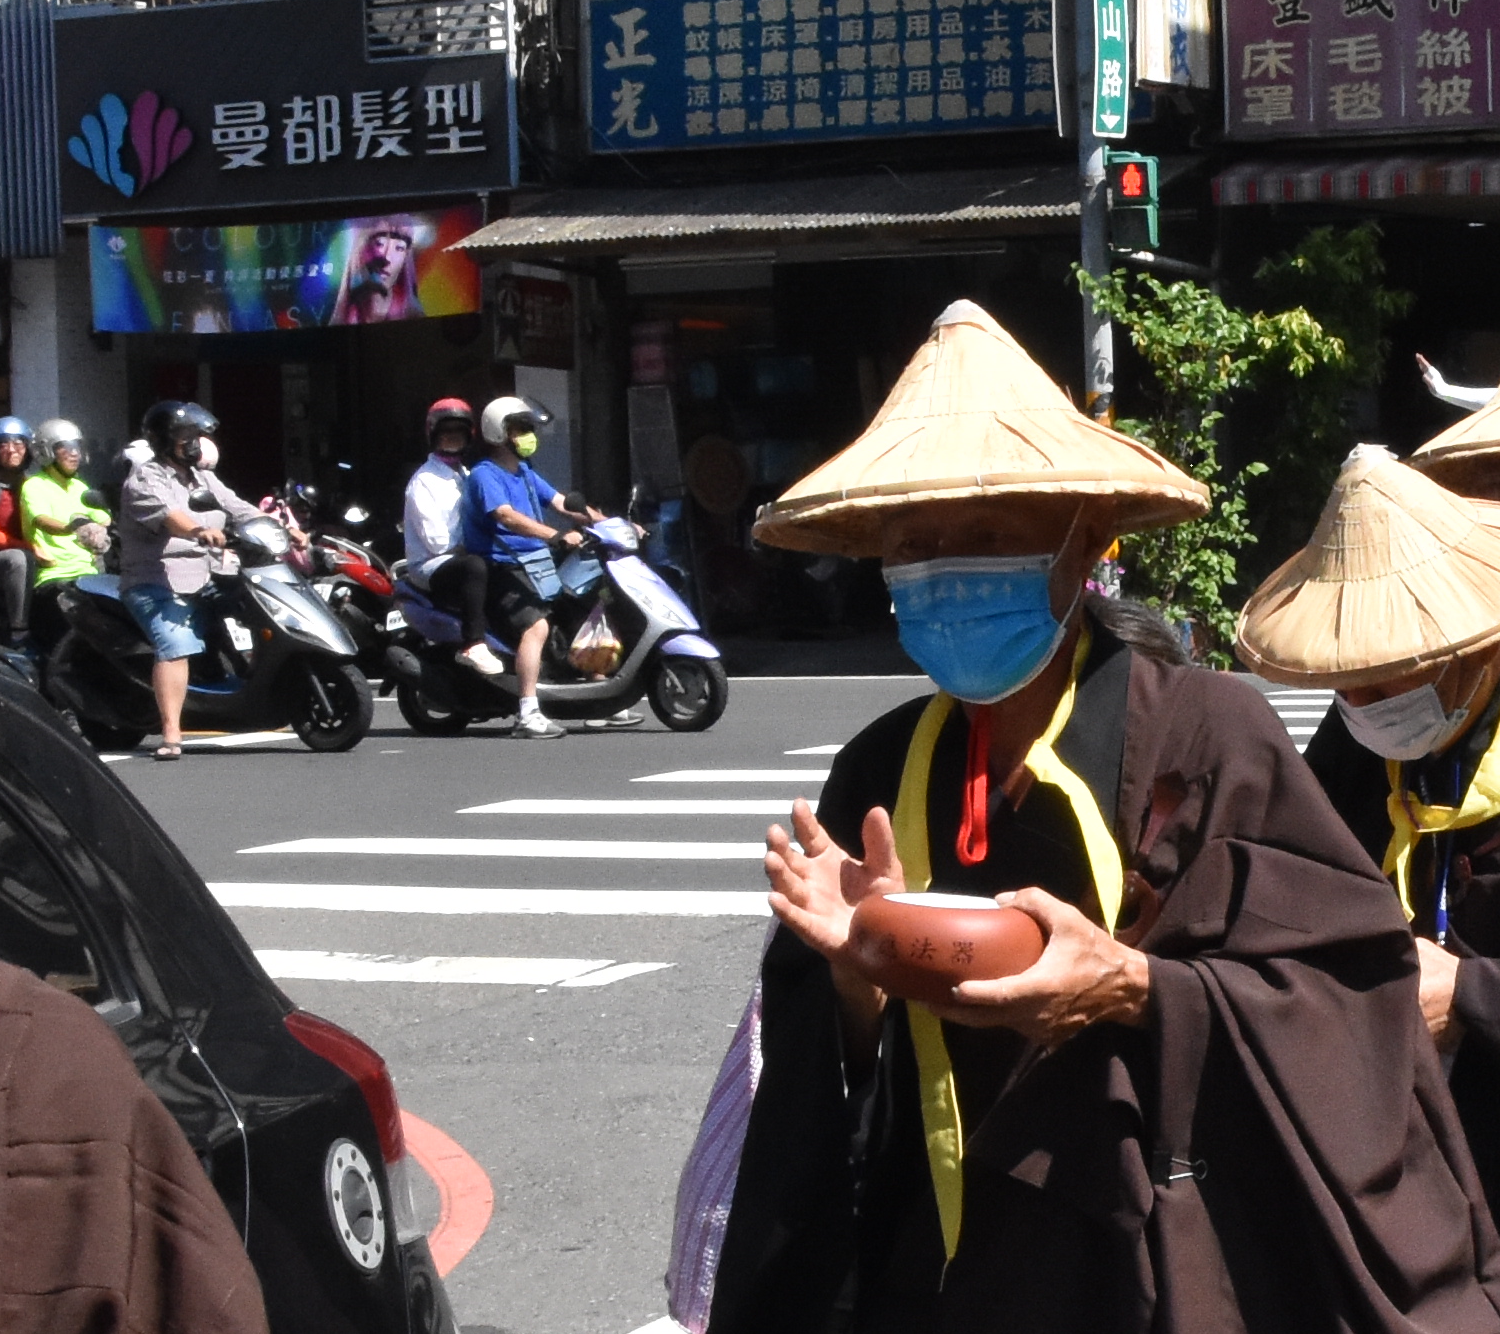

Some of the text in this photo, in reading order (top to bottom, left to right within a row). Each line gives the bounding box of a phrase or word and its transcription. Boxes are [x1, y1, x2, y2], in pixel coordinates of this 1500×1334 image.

[604, 7, 658, 138] 正光
[1241, 39, 1294, 126] 床罩
[1328, 34, 1382, 122] 毛毯
[1416, 28, 1472, 117] 絲被
[211, 79, 487, 170] 曼都髮型
[172, 305, 325, 334] FNTASY
